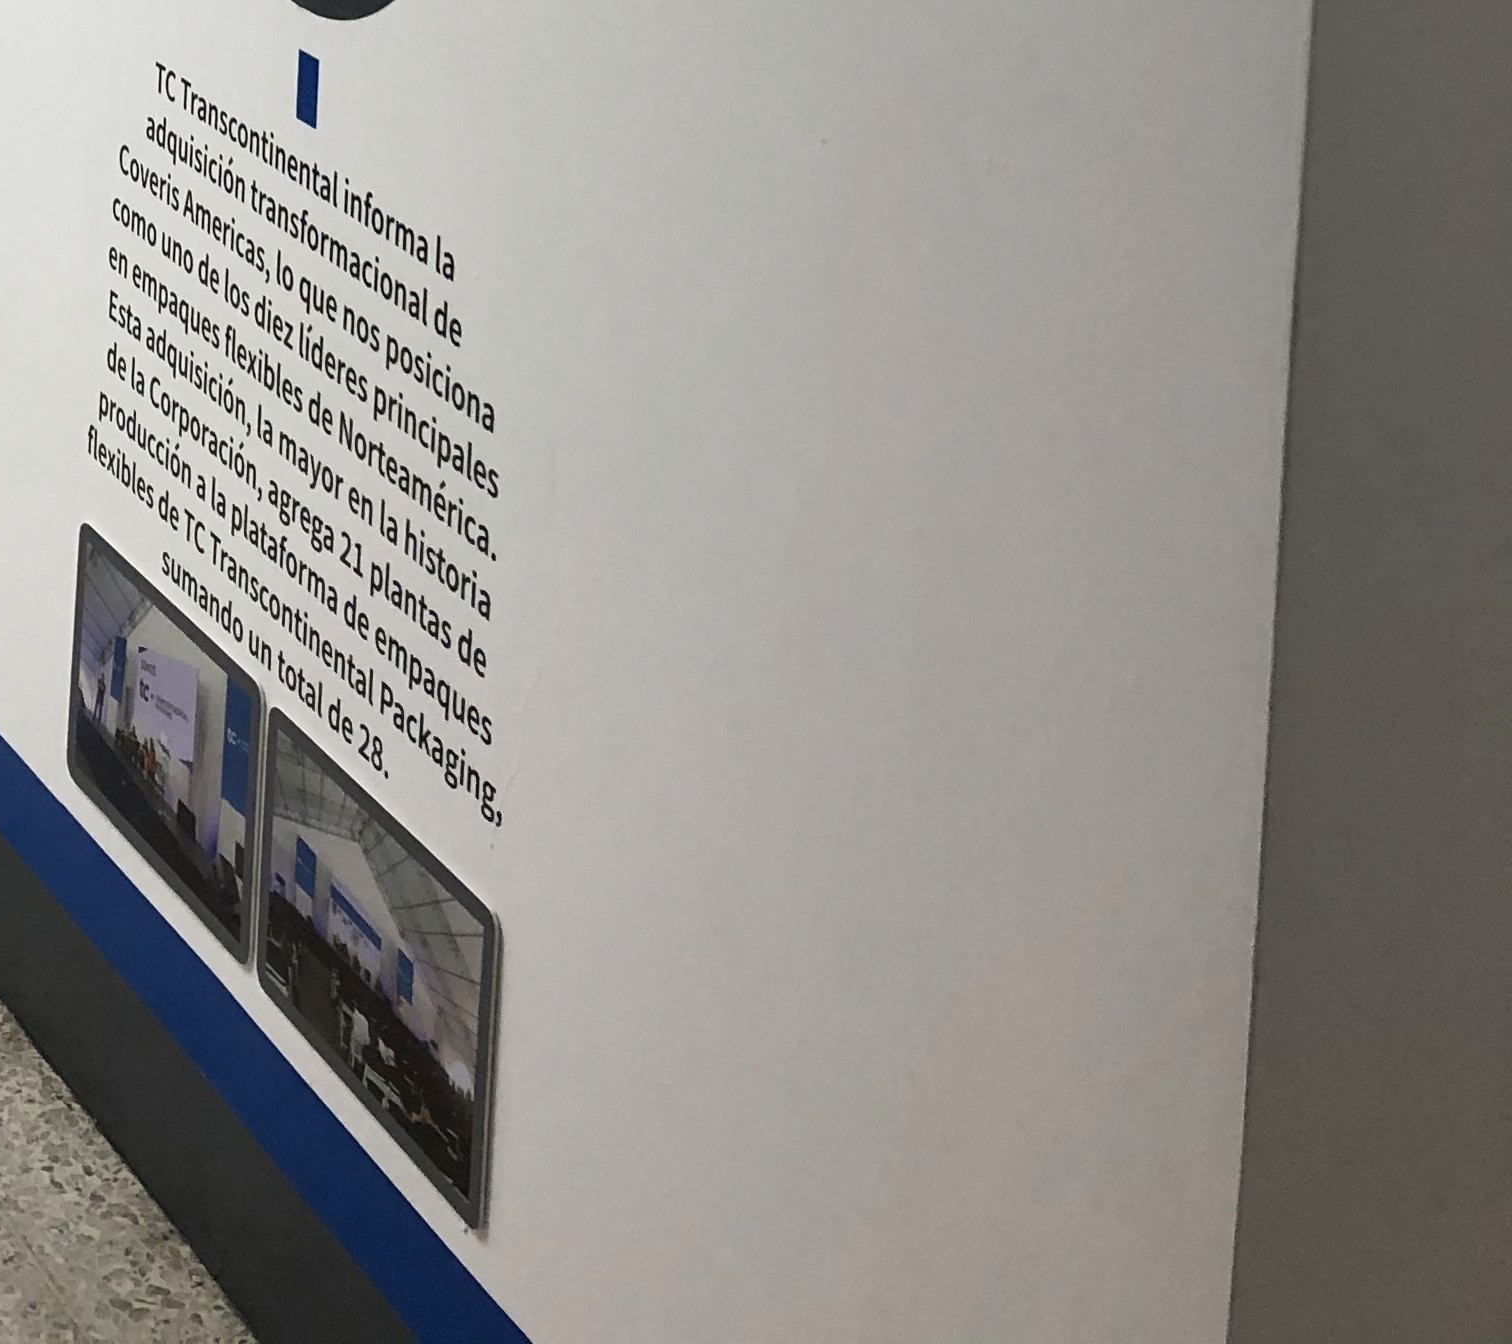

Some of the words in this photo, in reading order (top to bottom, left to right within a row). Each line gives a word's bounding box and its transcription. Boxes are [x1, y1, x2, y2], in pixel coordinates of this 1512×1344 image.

[119, 144, 179, 211] Coveris
[183, 189, 270, 284] Americas,
[276, 249, 294, 292] lo
[299, 277, 337, 323] que
[343, 305, 381, 352] nos
[385, 334, 495, 434] posiciona
[146, 117, 245, 204] adquisición
[251, 180, 428, 327] transformacional
[434, 300, 462, 347] de
[156, 61, 176, 102] TC
[181, 77, 338, 208] Transcontinental
[344, 177, 428, 265] informa
[435, 235, 455, 282] la
[109, 247, 128, 279] en
[132, 264, 220, 349] empaques
[225, 324, 303, 413] flexibles
[308, 391, 333, 436] de
[339, 411, 496, 561] Norteamérica.
[113, 198, 157, 247] como
[162, 231, 193, 274] uno
[198, 253, 220, 294] de
[224, 268, 250, 317] los
[254, 295, 294, 351] diez
[299, 322, 368, 403] líderes
[373, 385, 500, 498] principales
[88, 424, 154, 509] flexibles
[158, 490, 179, 531] de
[184, 508, 205, 554] TC
[210, 531, 374, 707] Transcontinental
[380, 681, 502, 827] Packaging,
[162, 552, 243, 643] sumando
[249, 630, 272, 671] un
[277, 650, 323, 719] total
[328, 697, 354, 744] de
[358, 724, 389, 779] 28.
